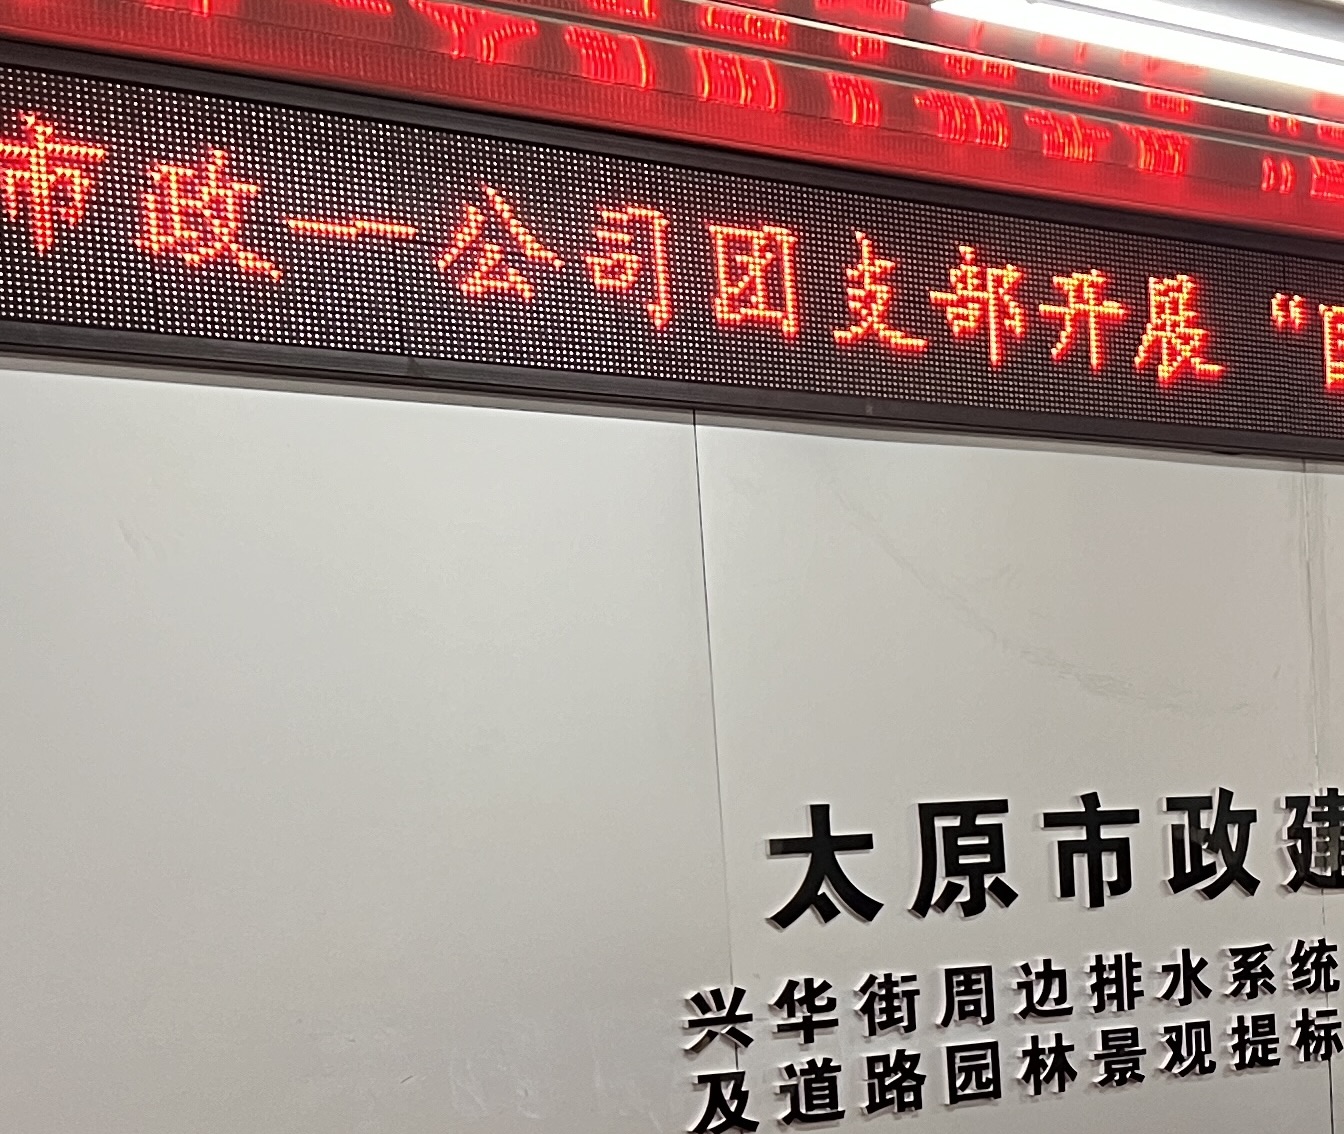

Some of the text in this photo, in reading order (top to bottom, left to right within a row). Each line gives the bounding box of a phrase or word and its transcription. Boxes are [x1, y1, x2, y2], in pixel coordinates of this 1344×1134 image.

[0, 110, 1222, 384] 市政一公司团支部开展
[683, 937, 1341, 1050] 兴华街周边排水系统
